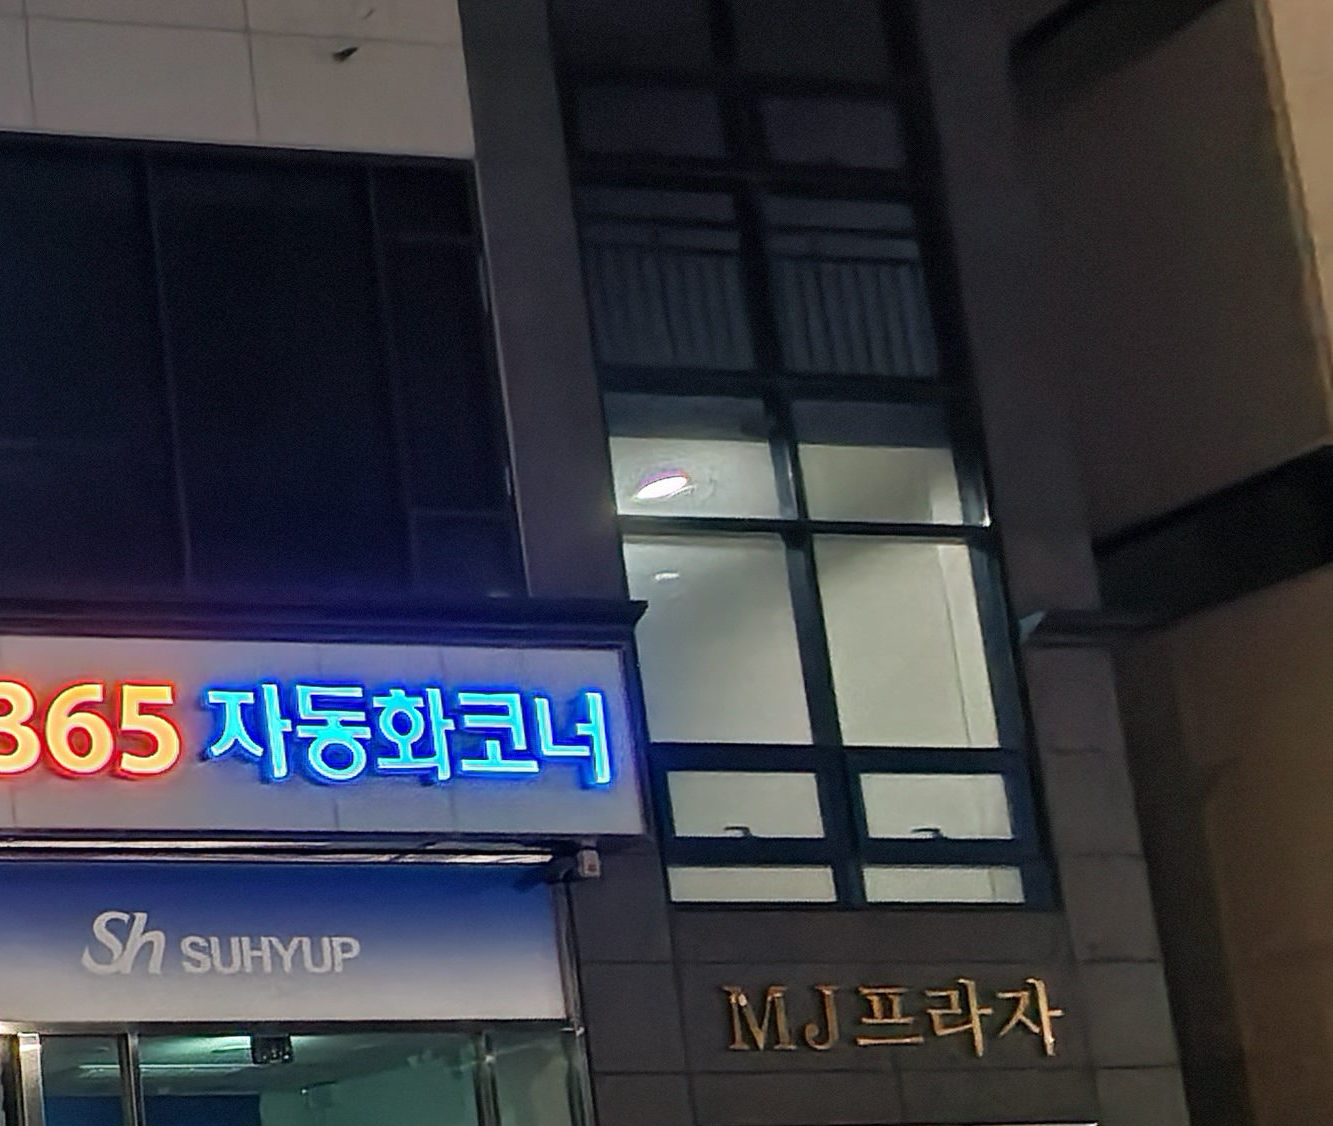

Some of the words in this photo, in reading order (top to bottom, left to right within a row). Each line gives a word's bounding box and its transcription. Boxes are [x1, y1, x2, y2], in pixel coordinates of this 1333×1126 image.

[207, 682, 612, 786] 자동화코너
[80, 910, 166, 976] Sh
[180, 935, 362, 975] SUHYUP
